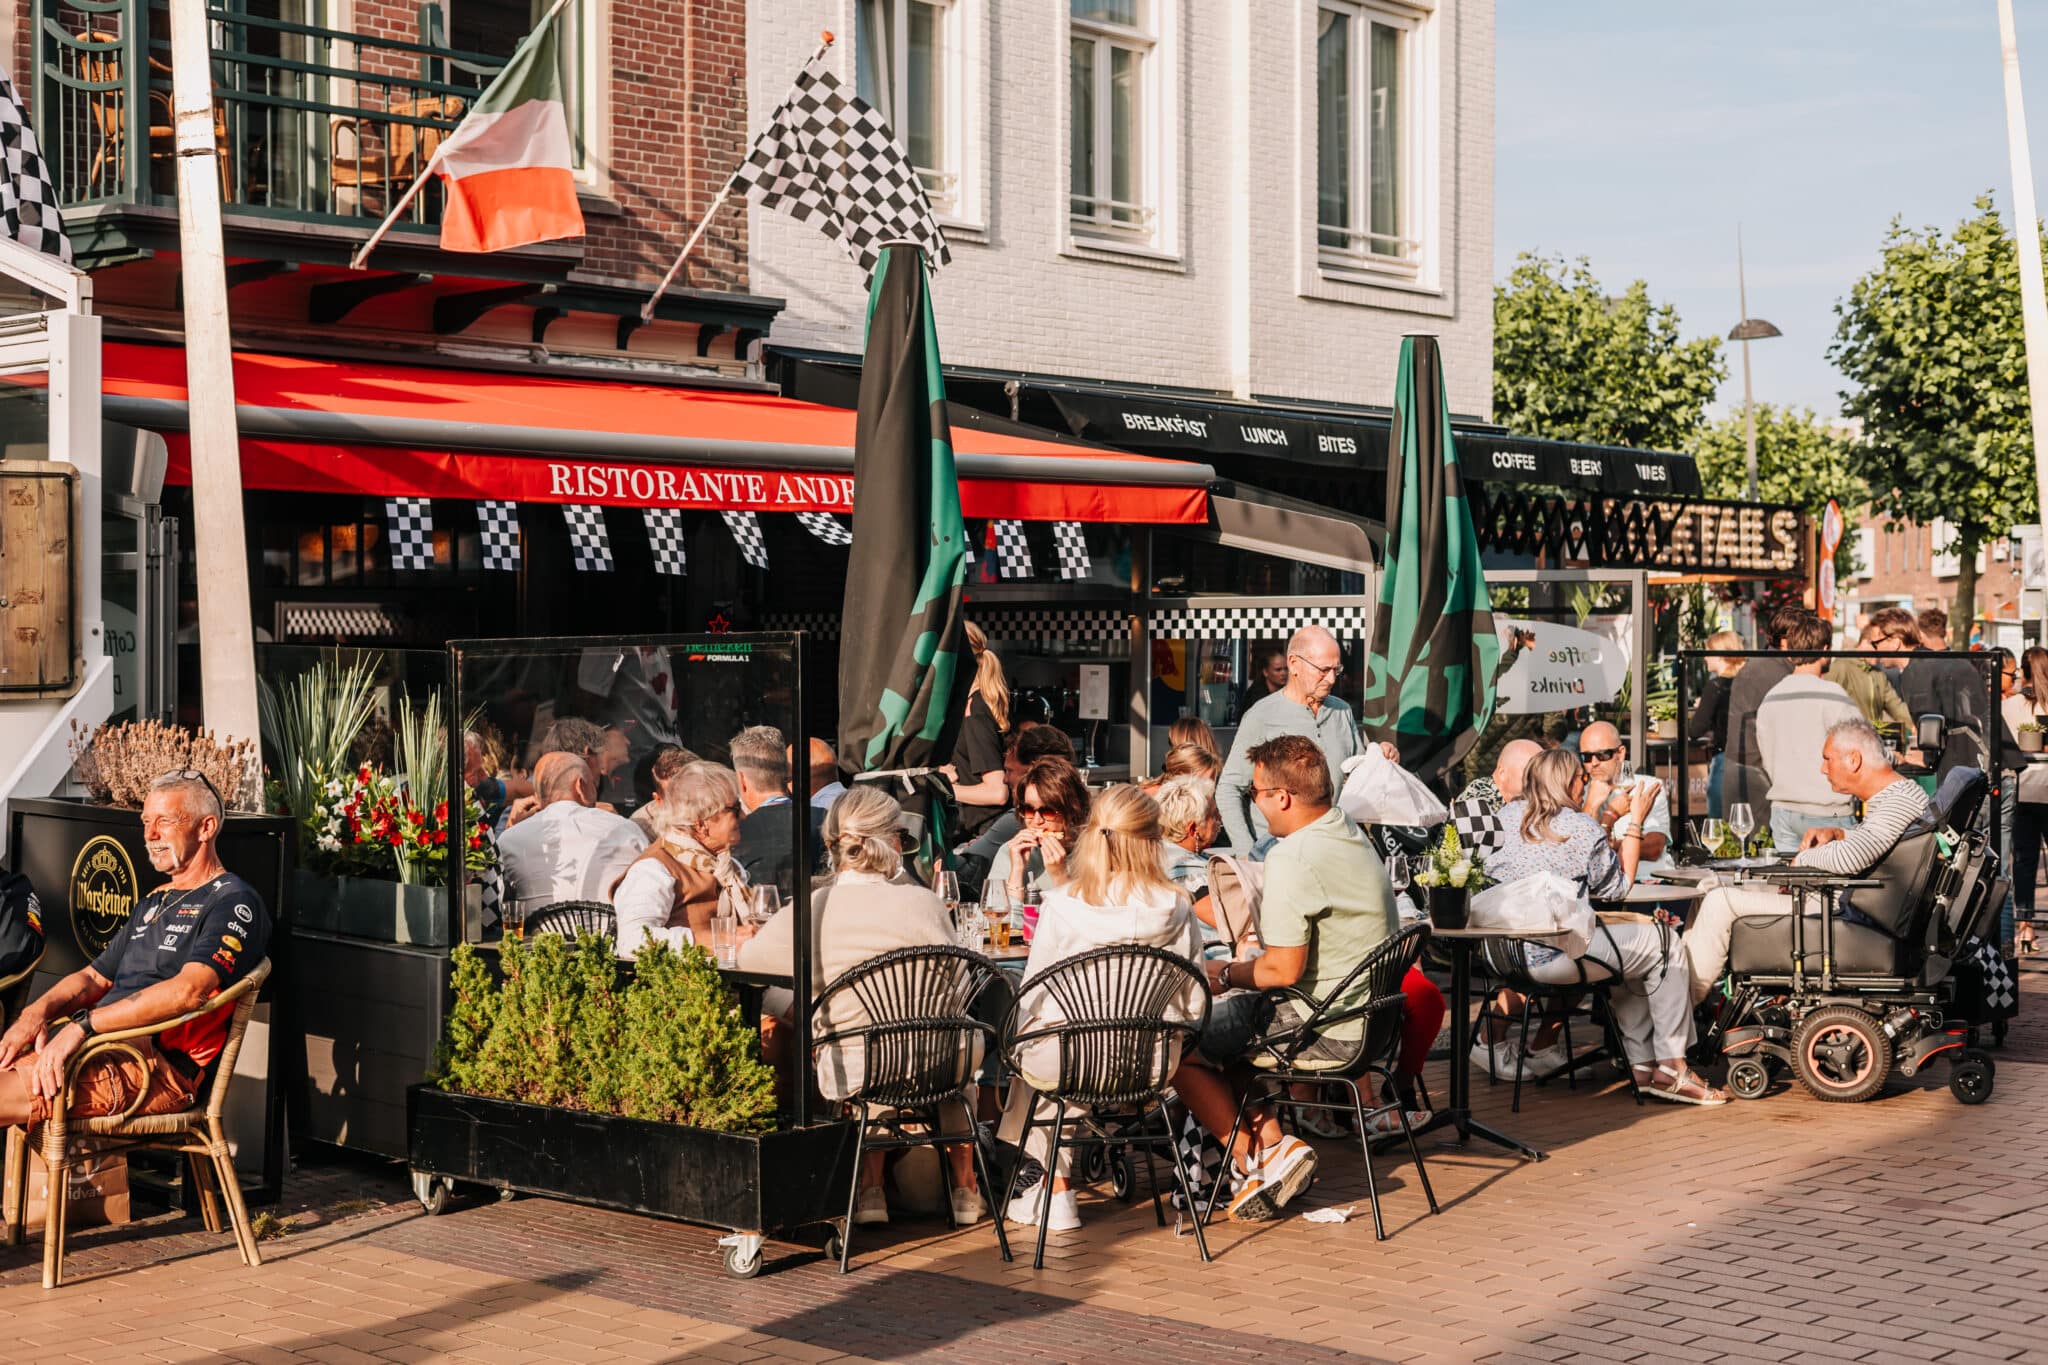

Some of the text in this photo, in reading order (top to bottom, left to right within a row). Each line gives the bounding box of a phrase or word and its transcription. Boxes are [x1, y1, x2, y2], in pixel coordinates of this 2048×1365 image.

[1121, 413, 1357, 454] BREAKFAST LUNCH BITES
[1492, 452, 1537, 471] COFFEE
[548, 463, 854, 506] RISTORANTE ANDR
[77, 881, 131, 918] Warsteiner
